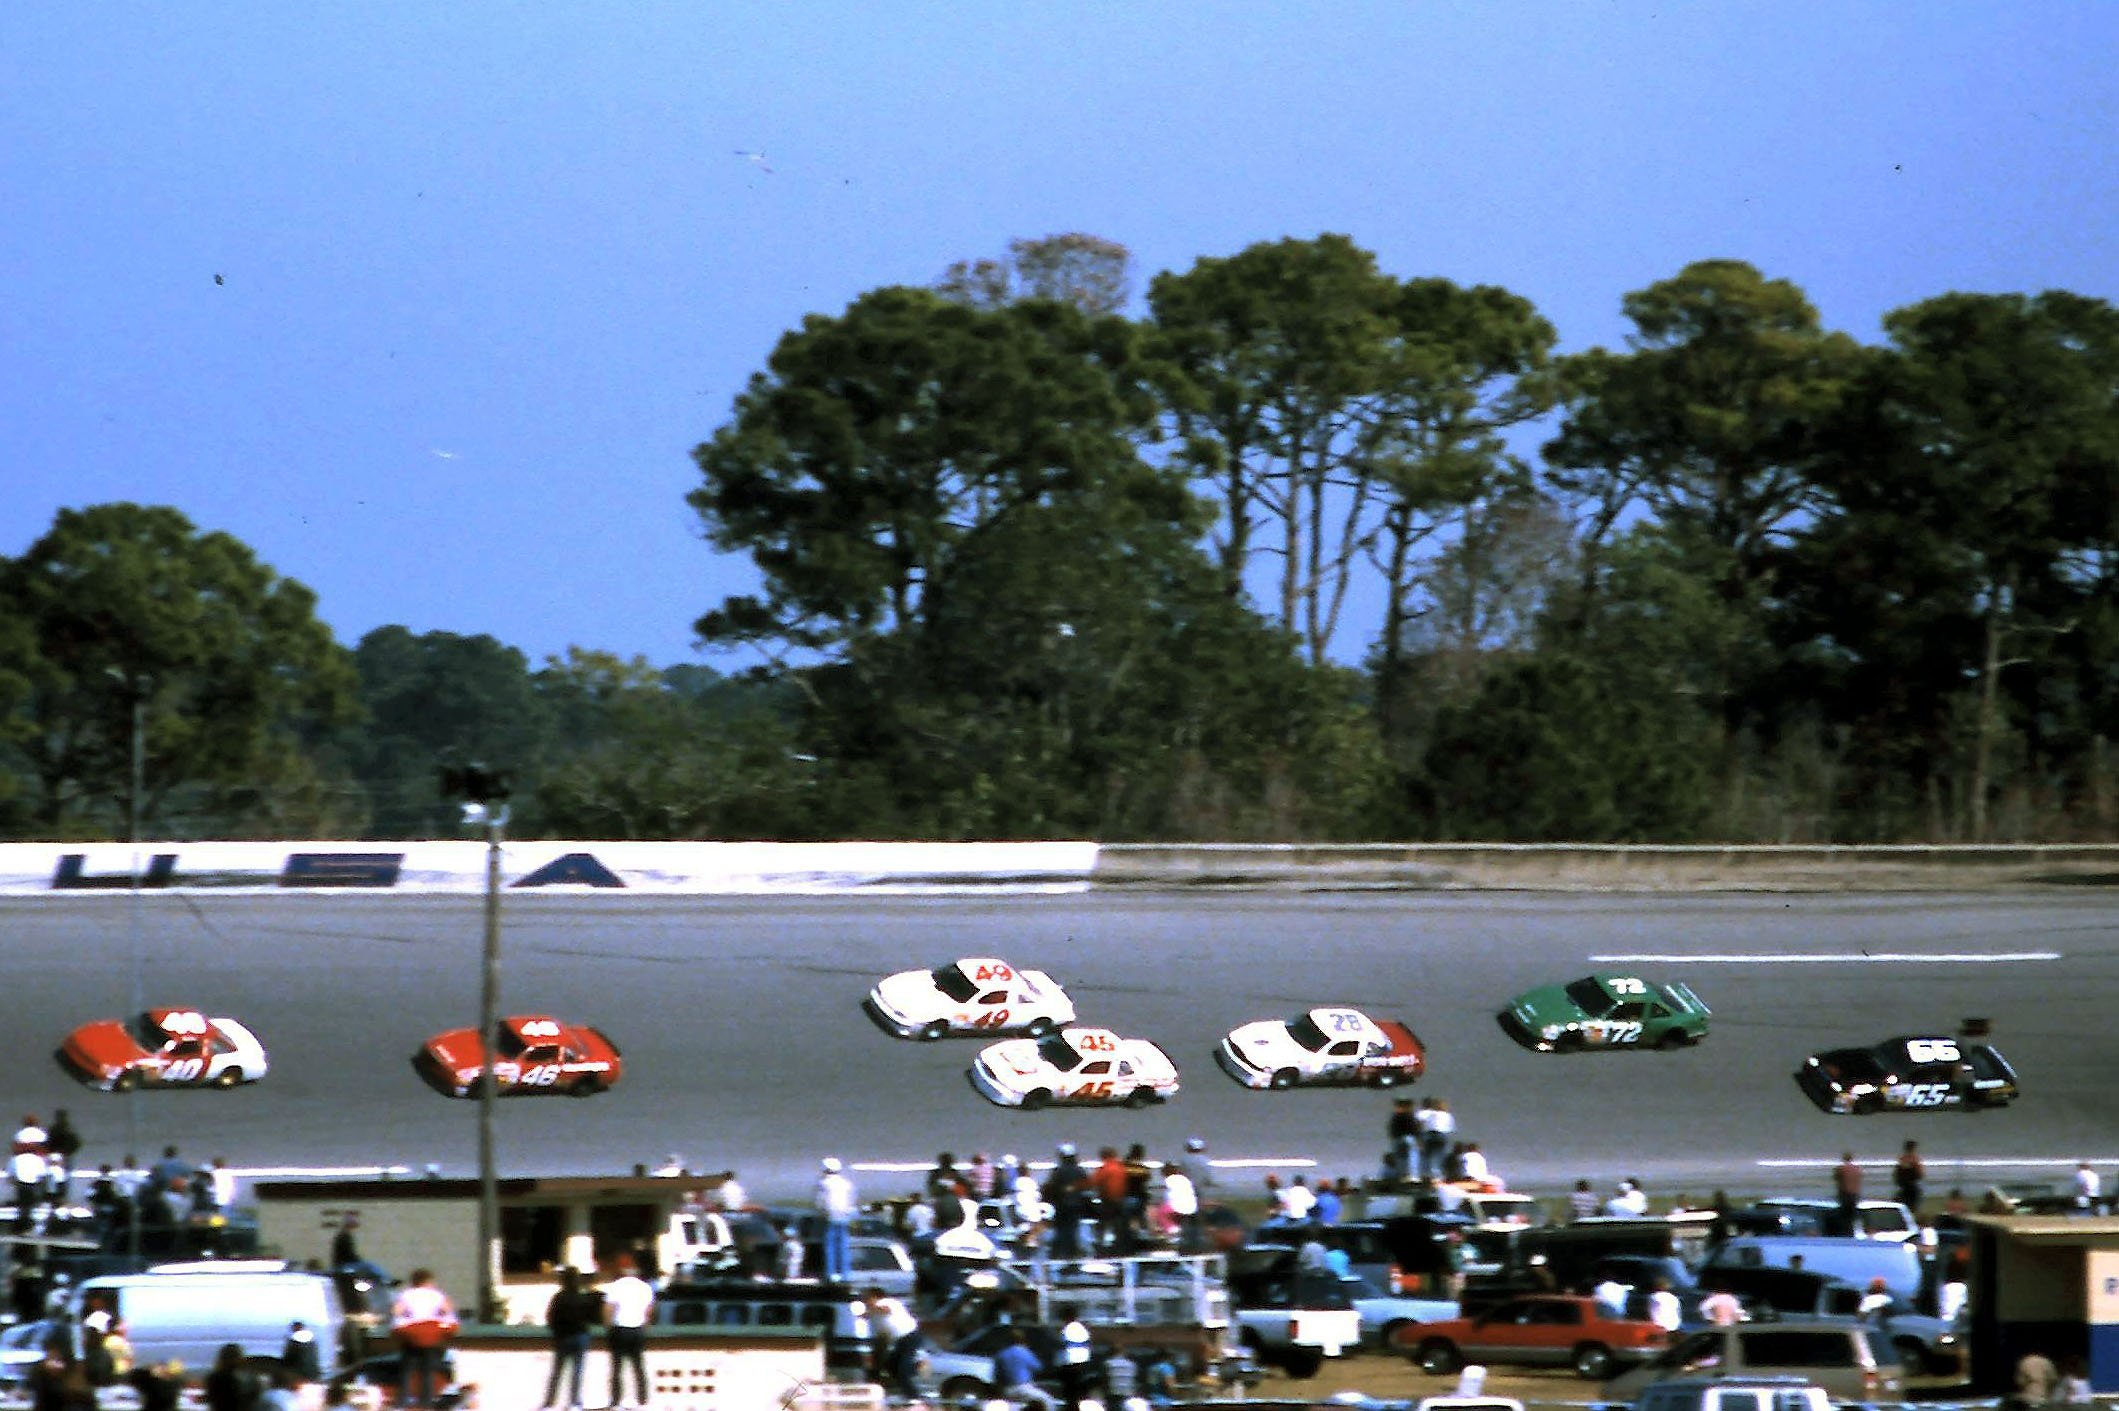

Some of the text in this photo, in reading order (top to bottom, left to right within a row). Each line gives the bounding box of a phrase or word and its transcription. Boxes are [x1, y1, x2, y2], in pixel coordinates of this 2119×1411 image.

[976, 965, 1012, 981] 49
[1608, 978, 1647, 994] 72
[1611, 1021, 1643, 1043] 72
[521, 1064, 560, 1086] 46
[1070, 1082, 1112, 1098] 45
